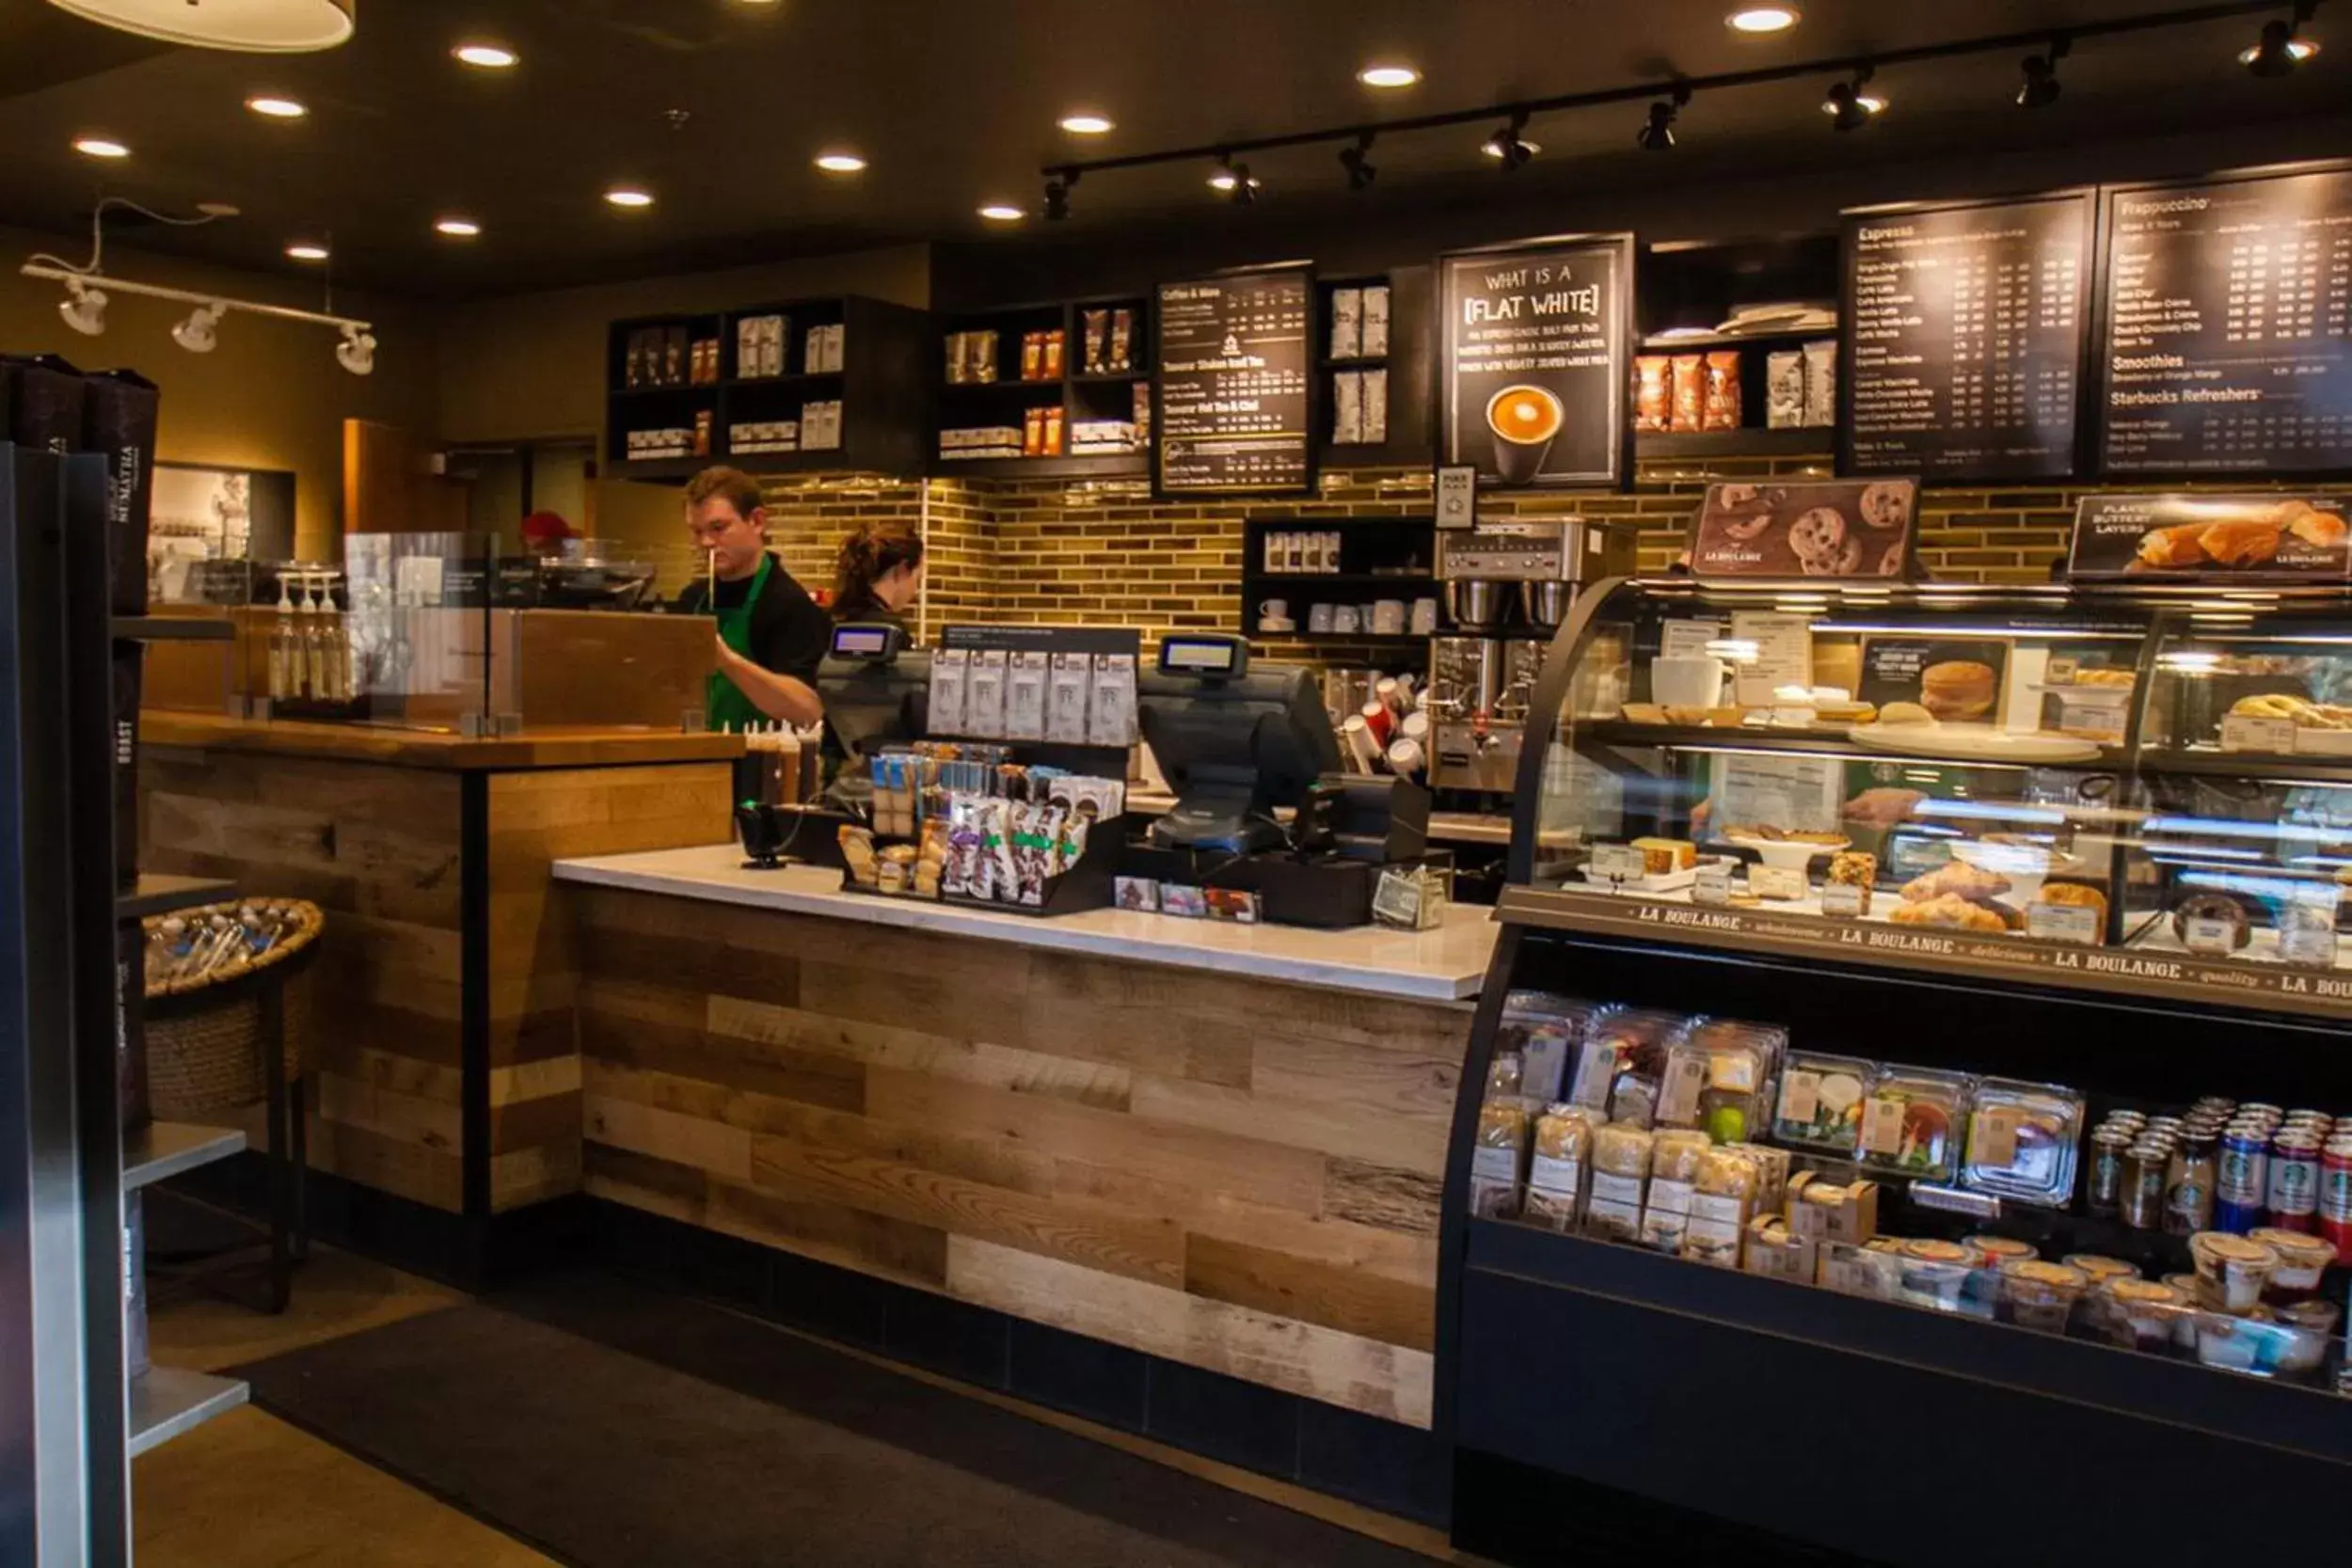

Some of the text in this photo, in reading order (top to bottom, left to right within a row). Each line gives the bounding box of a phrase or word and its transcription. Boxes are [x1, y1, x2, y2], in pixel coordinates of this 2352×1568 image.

[1485, 264, 1572, 291] WHAT IS A
[1465, 283, 1599, 325] [FLAT WHITE]
[2112, 354, 2184, 372] Smoothies
[2110, 388, 2179, 406] Starbucks
[1639, 906, 1660, 922] LA
[1663, 910, 1740, 930] BOULANGE
[1841, 928, 1862, 943] LA
[1868, 932, 1954, 954] BOULANGE
[2056, 951, 2078, 968] LA
[2086, 955, 2182, 979] BOULANGE
[2200, 970, 2258, 988] quality
[2281, 975, 2307, 992] LA
